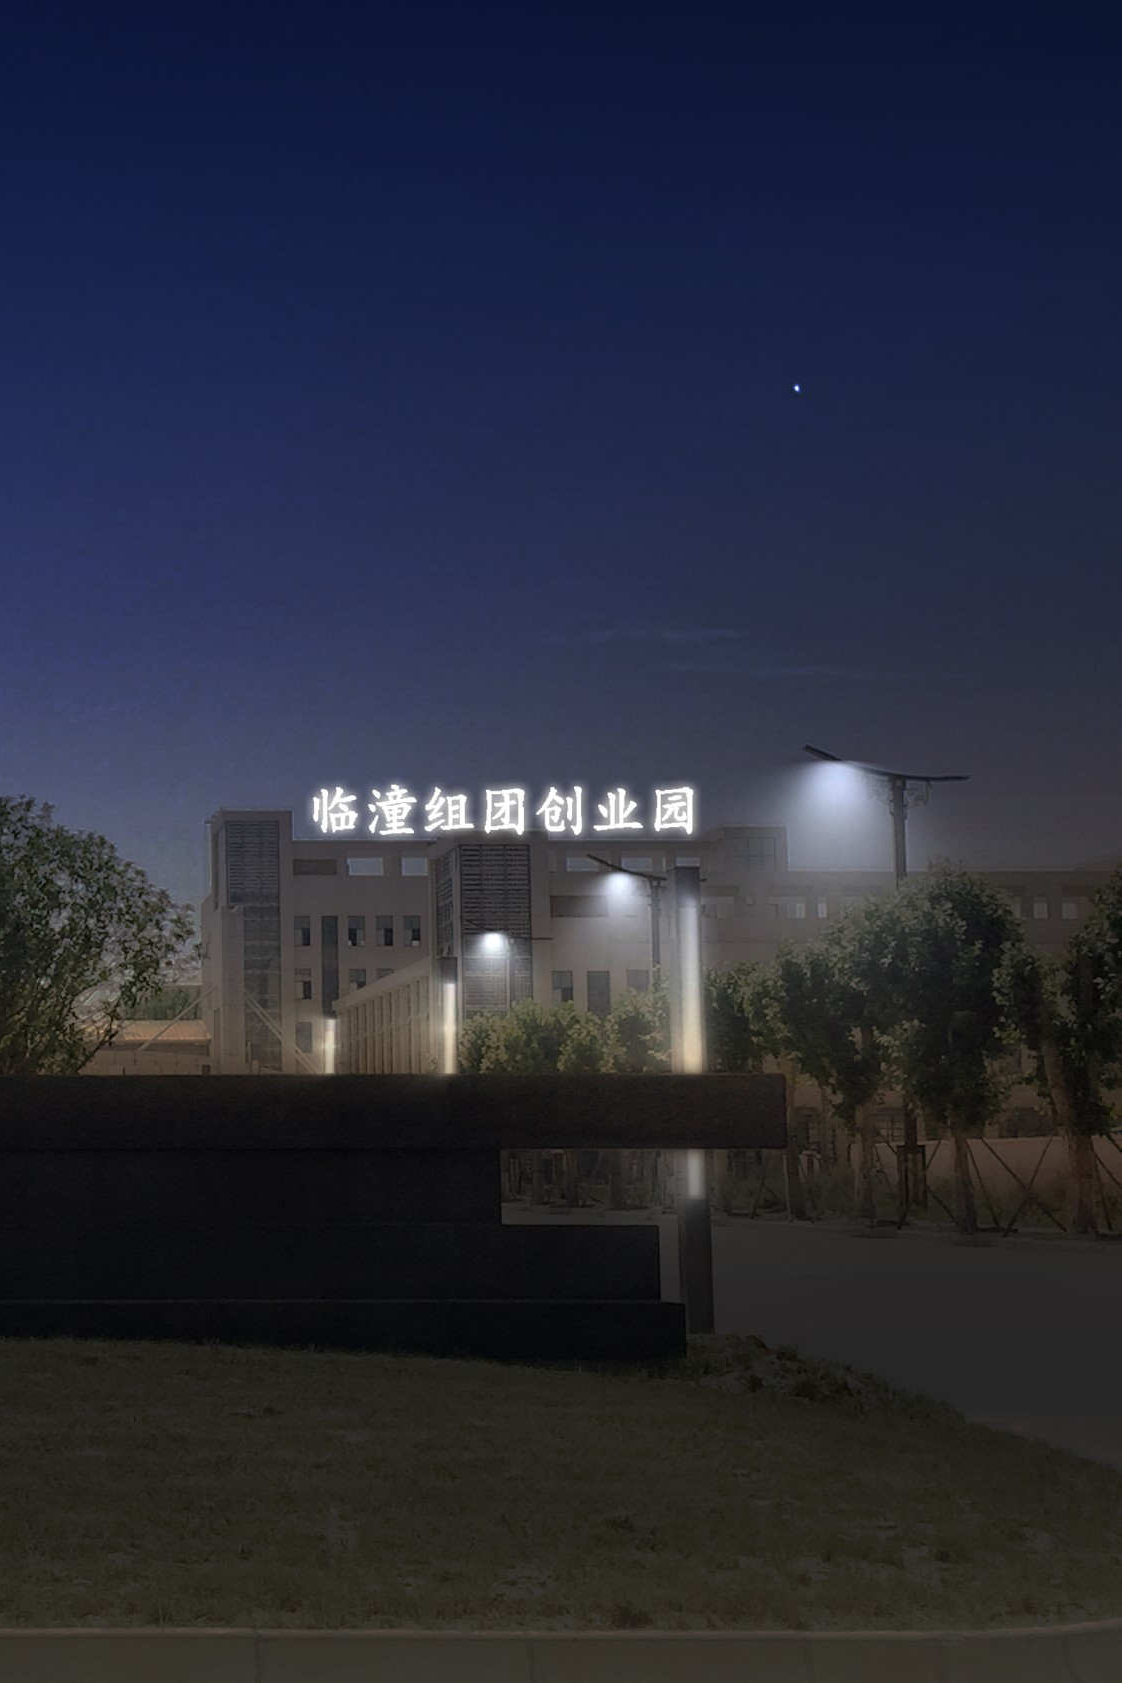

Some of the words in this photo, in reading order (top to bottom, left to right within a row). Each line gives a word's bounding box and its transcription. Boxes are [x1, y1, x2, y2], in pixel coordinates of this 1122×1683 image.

[312, 784, 694, 836] 临潼组团创业园
